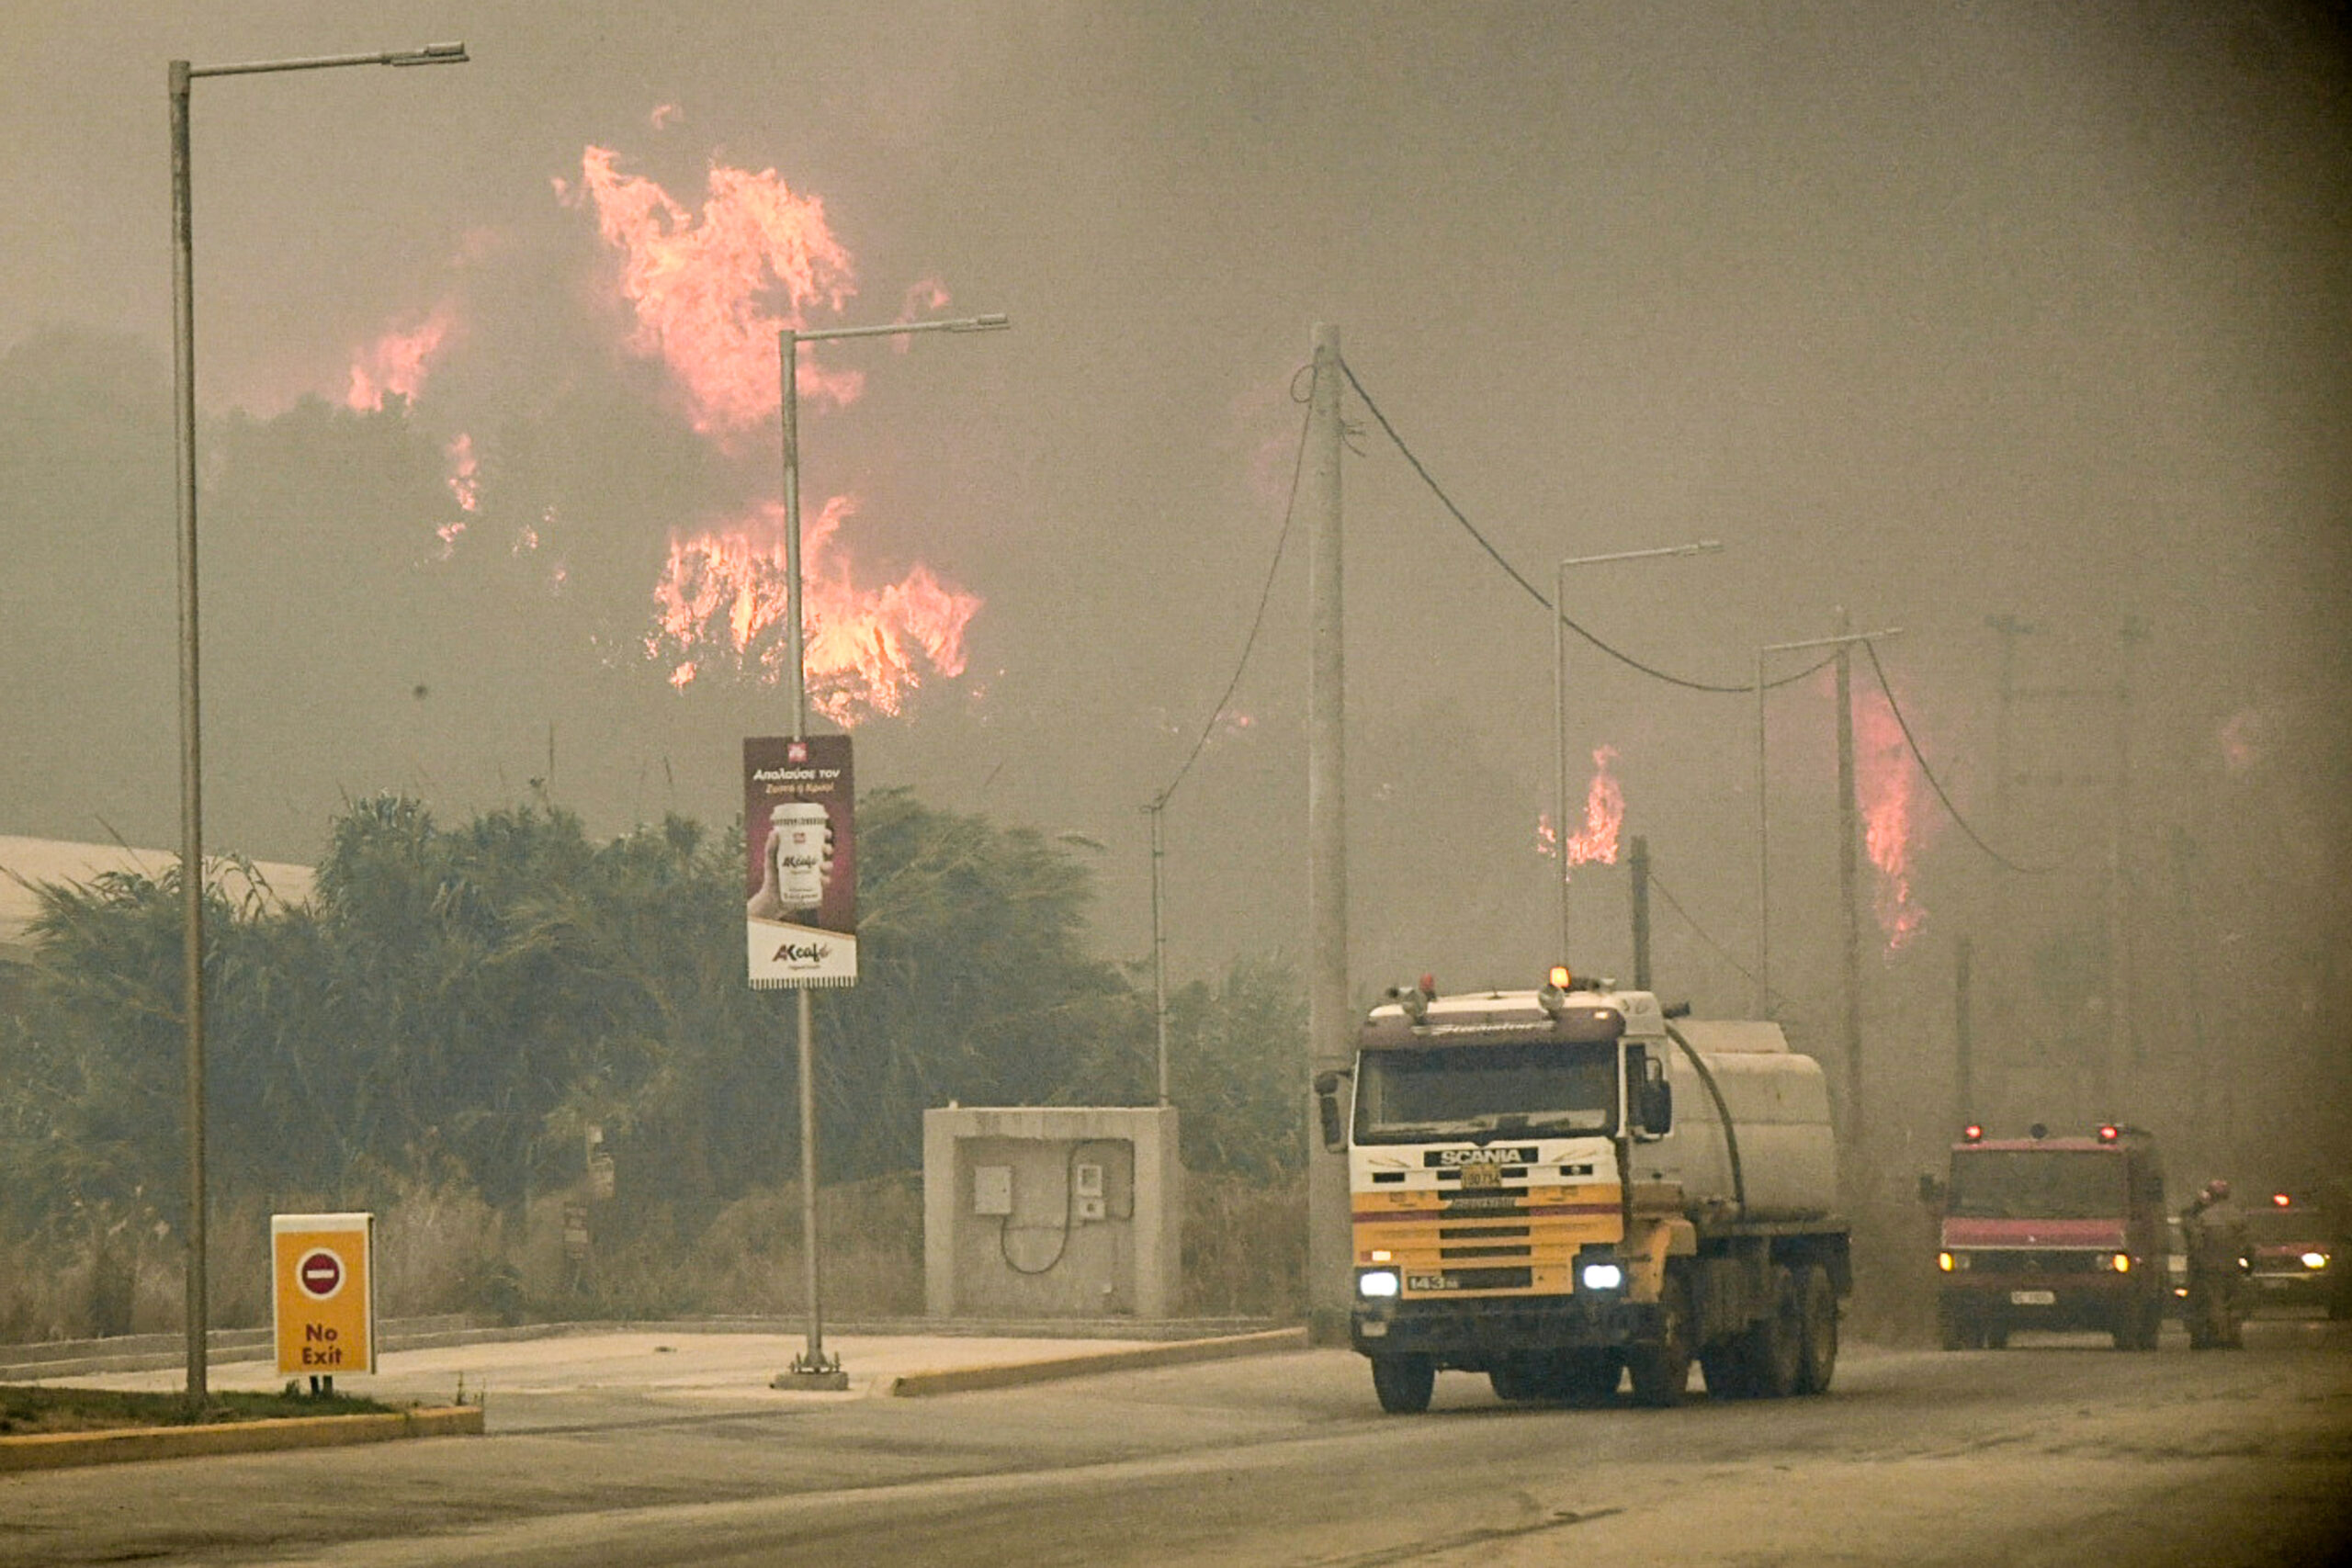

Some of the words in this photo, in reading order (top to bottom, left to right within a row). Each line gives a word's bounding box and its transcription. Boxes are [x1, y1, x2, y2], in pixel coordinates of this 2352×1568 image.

[1440, 1148, 1521, 1166] SCANIA
[305, 1323, 338, 1342] No
[302, 1346, 342, 1366] Exit
